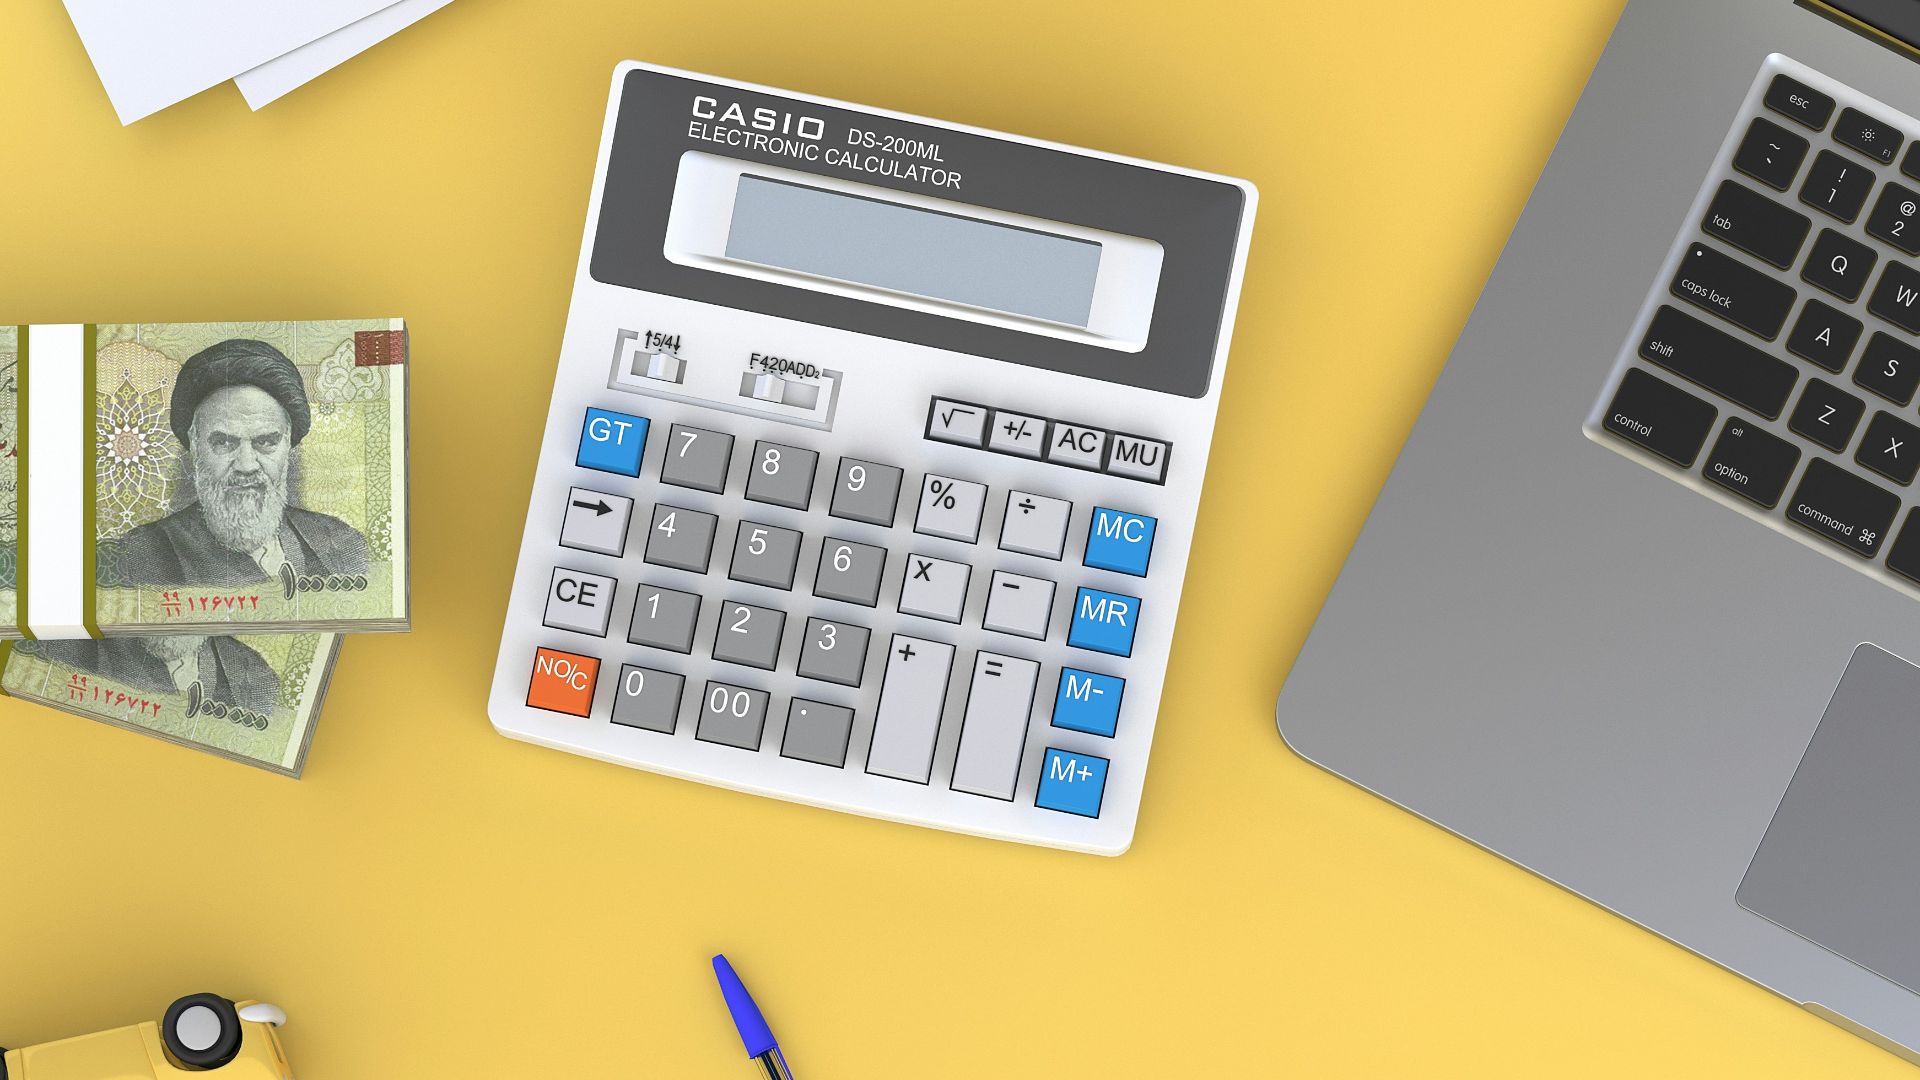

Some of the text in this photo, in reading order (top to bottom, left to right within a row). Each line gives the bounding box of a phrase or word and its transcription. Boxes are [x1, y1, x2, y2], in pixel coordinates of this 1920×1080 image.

[1789, 94, 1809, 109] esc
[691, 95, 826, 141] CASIO
[687, 121, 962, 190] ELECTRONIC CALCULATOR
[847, 127, 946, 163] DS-200ML
[1882, 148, 1891, 158] F1
[1828, 188, 1837, 203] 1
[1900, 201, 1917, 217] @
[1712, 214, 1731, 230] tab
[1891, 220, 1905, 237] 2
[1831, 255, 1848, 276] Q
[1681, 277, 1732, 309] caps lock
[1896, 285, 1919, 307] W
[1649, 341, 1674, 358] shift
[1815, 327, 1831, 347] A
[1883, 359, 1899, 377] S
[1614, 413, 1653, 437] control
[1818, 404, 1836, 425] Z
[589, 417, 633, 445] GT
[679, 431, 698, 458] 7
[1057, 426, 1099, 453] AC
[1732, 428, 1744, 437] alt
[1115, 439, 1161, 467] MU
[1884, 437, 1904, 458] X
[762, 448, 781, 475] 8
[1714, 463, 1749, 485] option
[847, 465, 866, 492] 9
[930, 478, 958, 510] %
[657, 512, 676, 538] 4
[1096, 511, 1147, 543] MC
[1797, 505, 1854, 536] command
[748, 528, 768, 555] 5
[833, 545, 853, 572] 6
[556, 578, 599, 608] CE
[648, 593, 660, 619] 1
[730, 606, 751, 634] 2
[1080, 595, 1128, 627] MR
[818, 623, 837, 651] 3
[536, 652, 590, 691] NO/C
[625, 670, 644, 697] 0
[1065, 674, 1104, 702] M-
[710, 687, 750, 718] 00
[1050, 755, 1093, 783] M+
